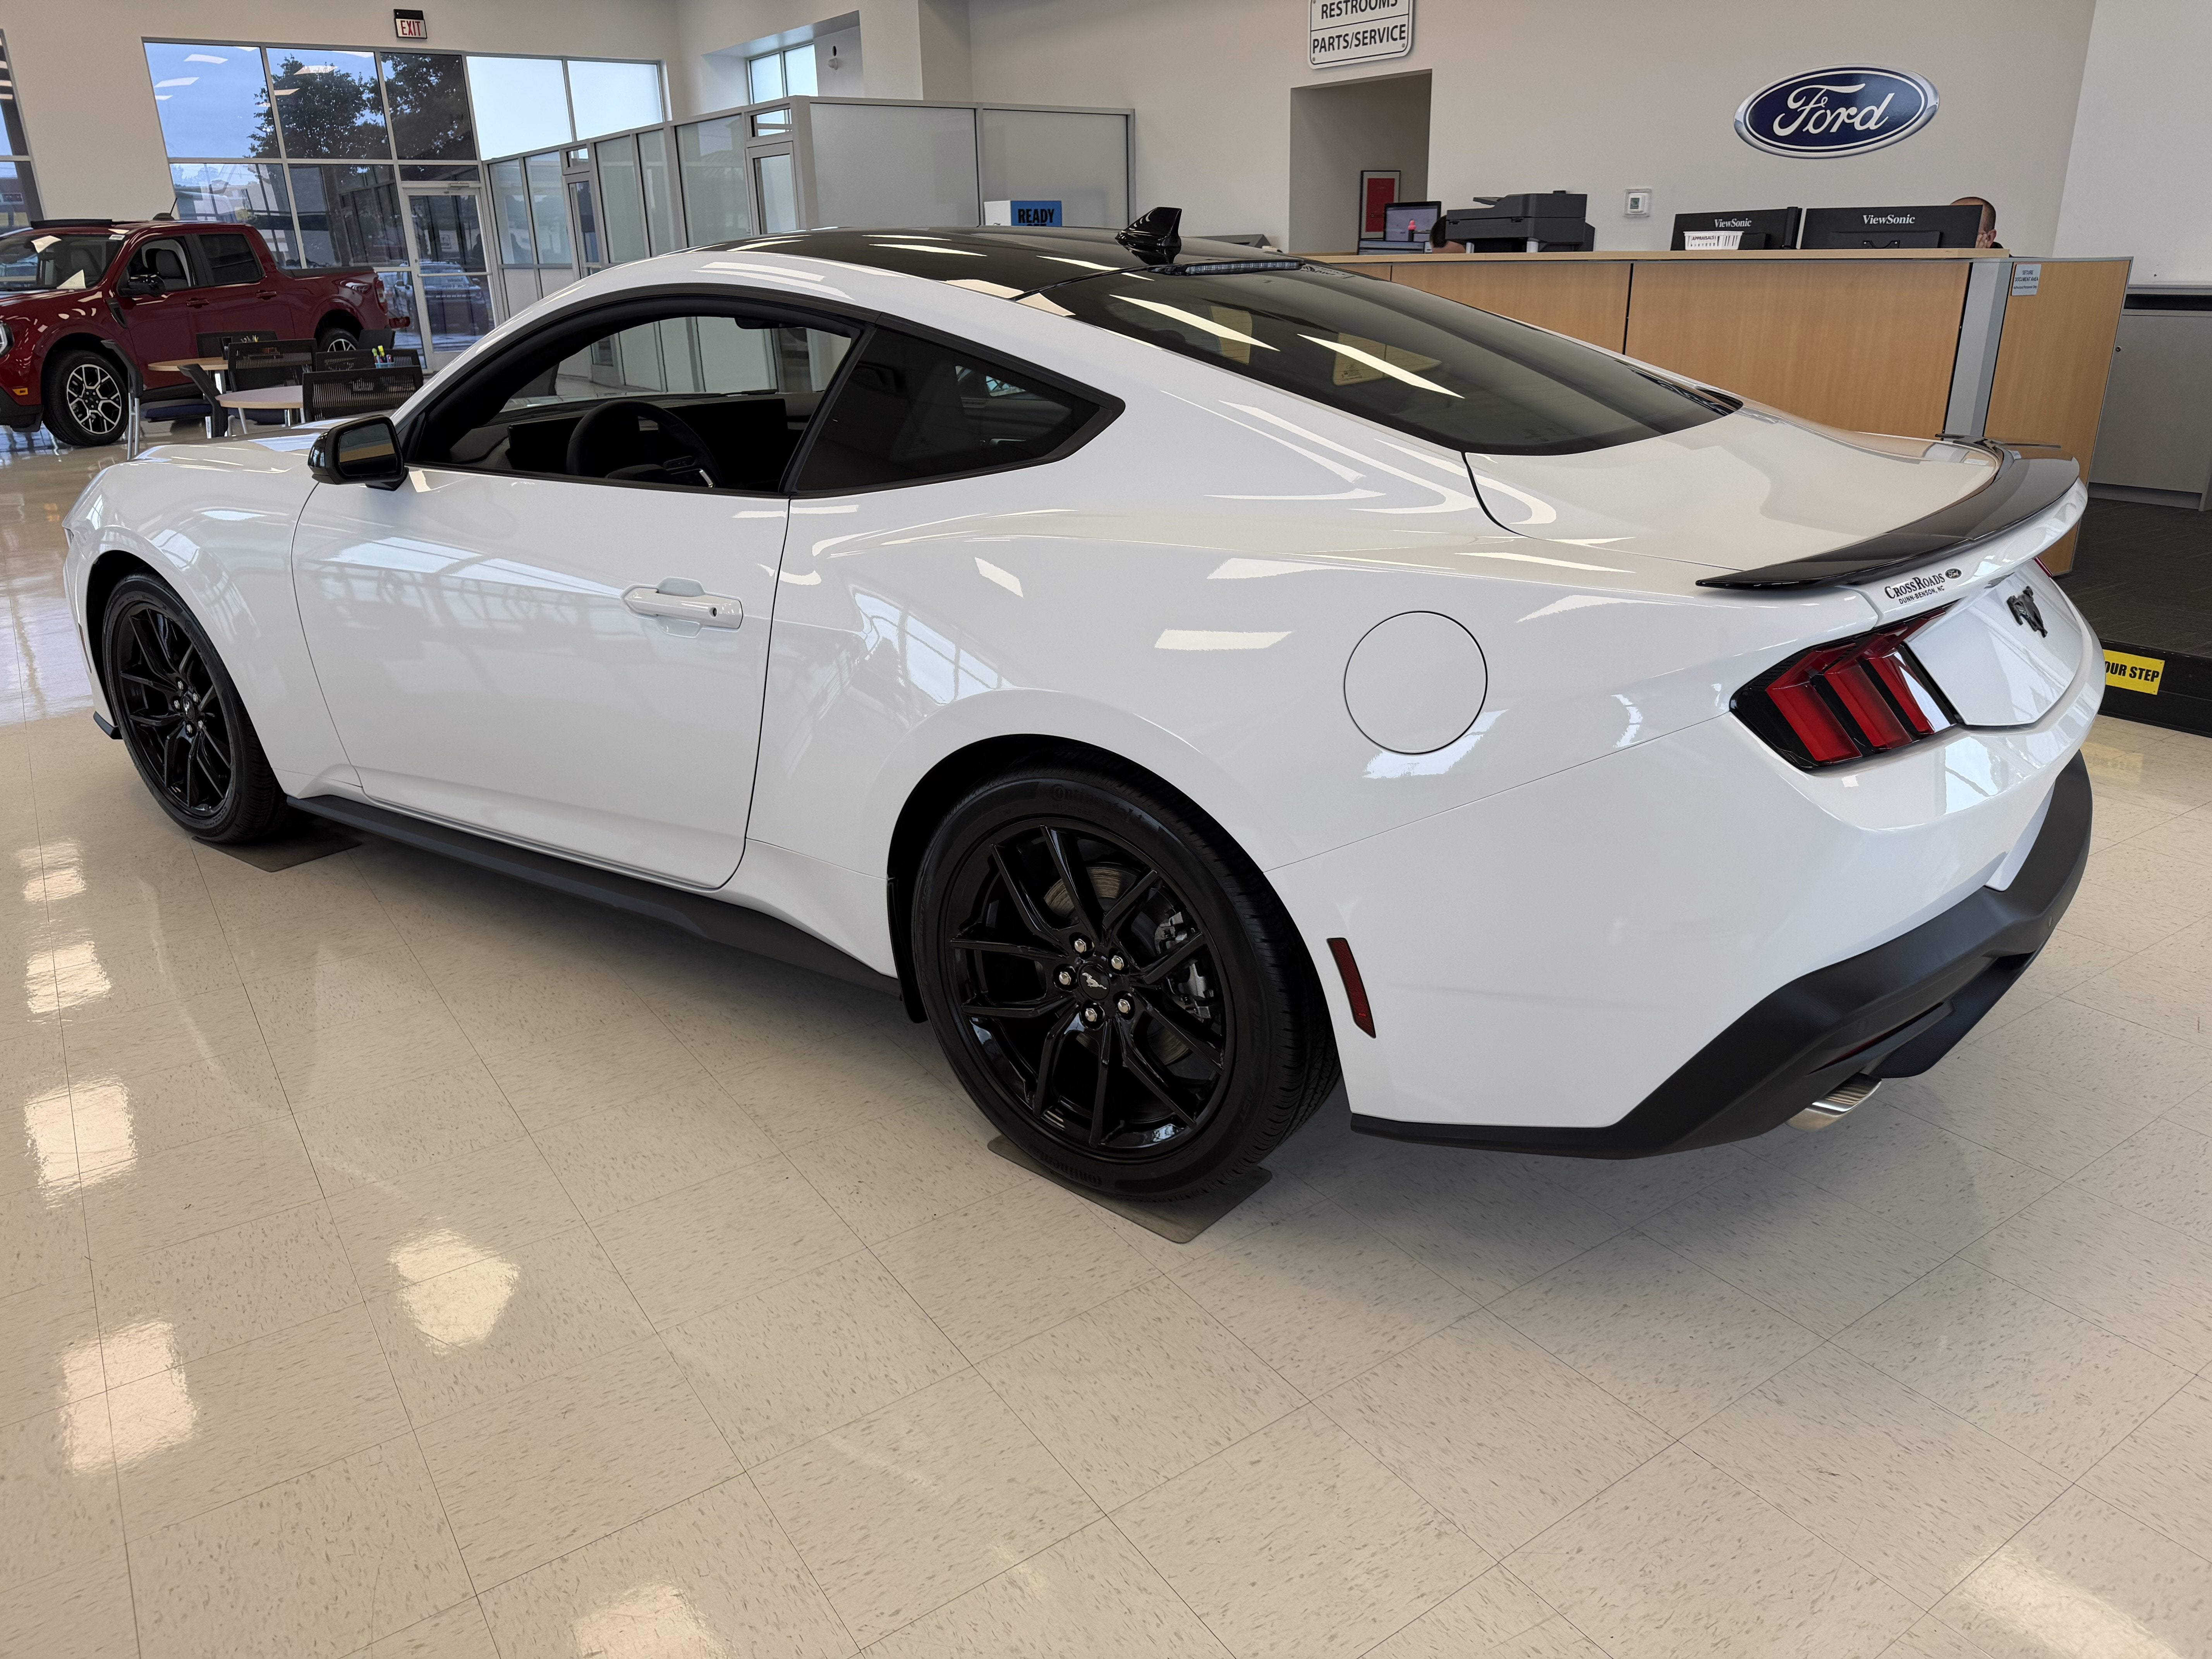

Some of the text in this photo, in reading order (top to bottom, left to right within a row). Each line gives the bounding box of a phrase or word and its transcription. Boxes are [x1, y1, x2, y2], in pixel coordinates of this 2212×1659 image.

[400, 20, 421, 36] EXIT
[1312, 24, 1406, 54] PARTS/SERVICE
[1773, 83, 1895, 136] Ford
[1018, 208, 1054, 223] READY
[1714, 218, 1752, 228] ViewSonic
[1863, 214, 1915, 224] ViewSonic
[2105, 661, 2160, 682] OUR STEP
